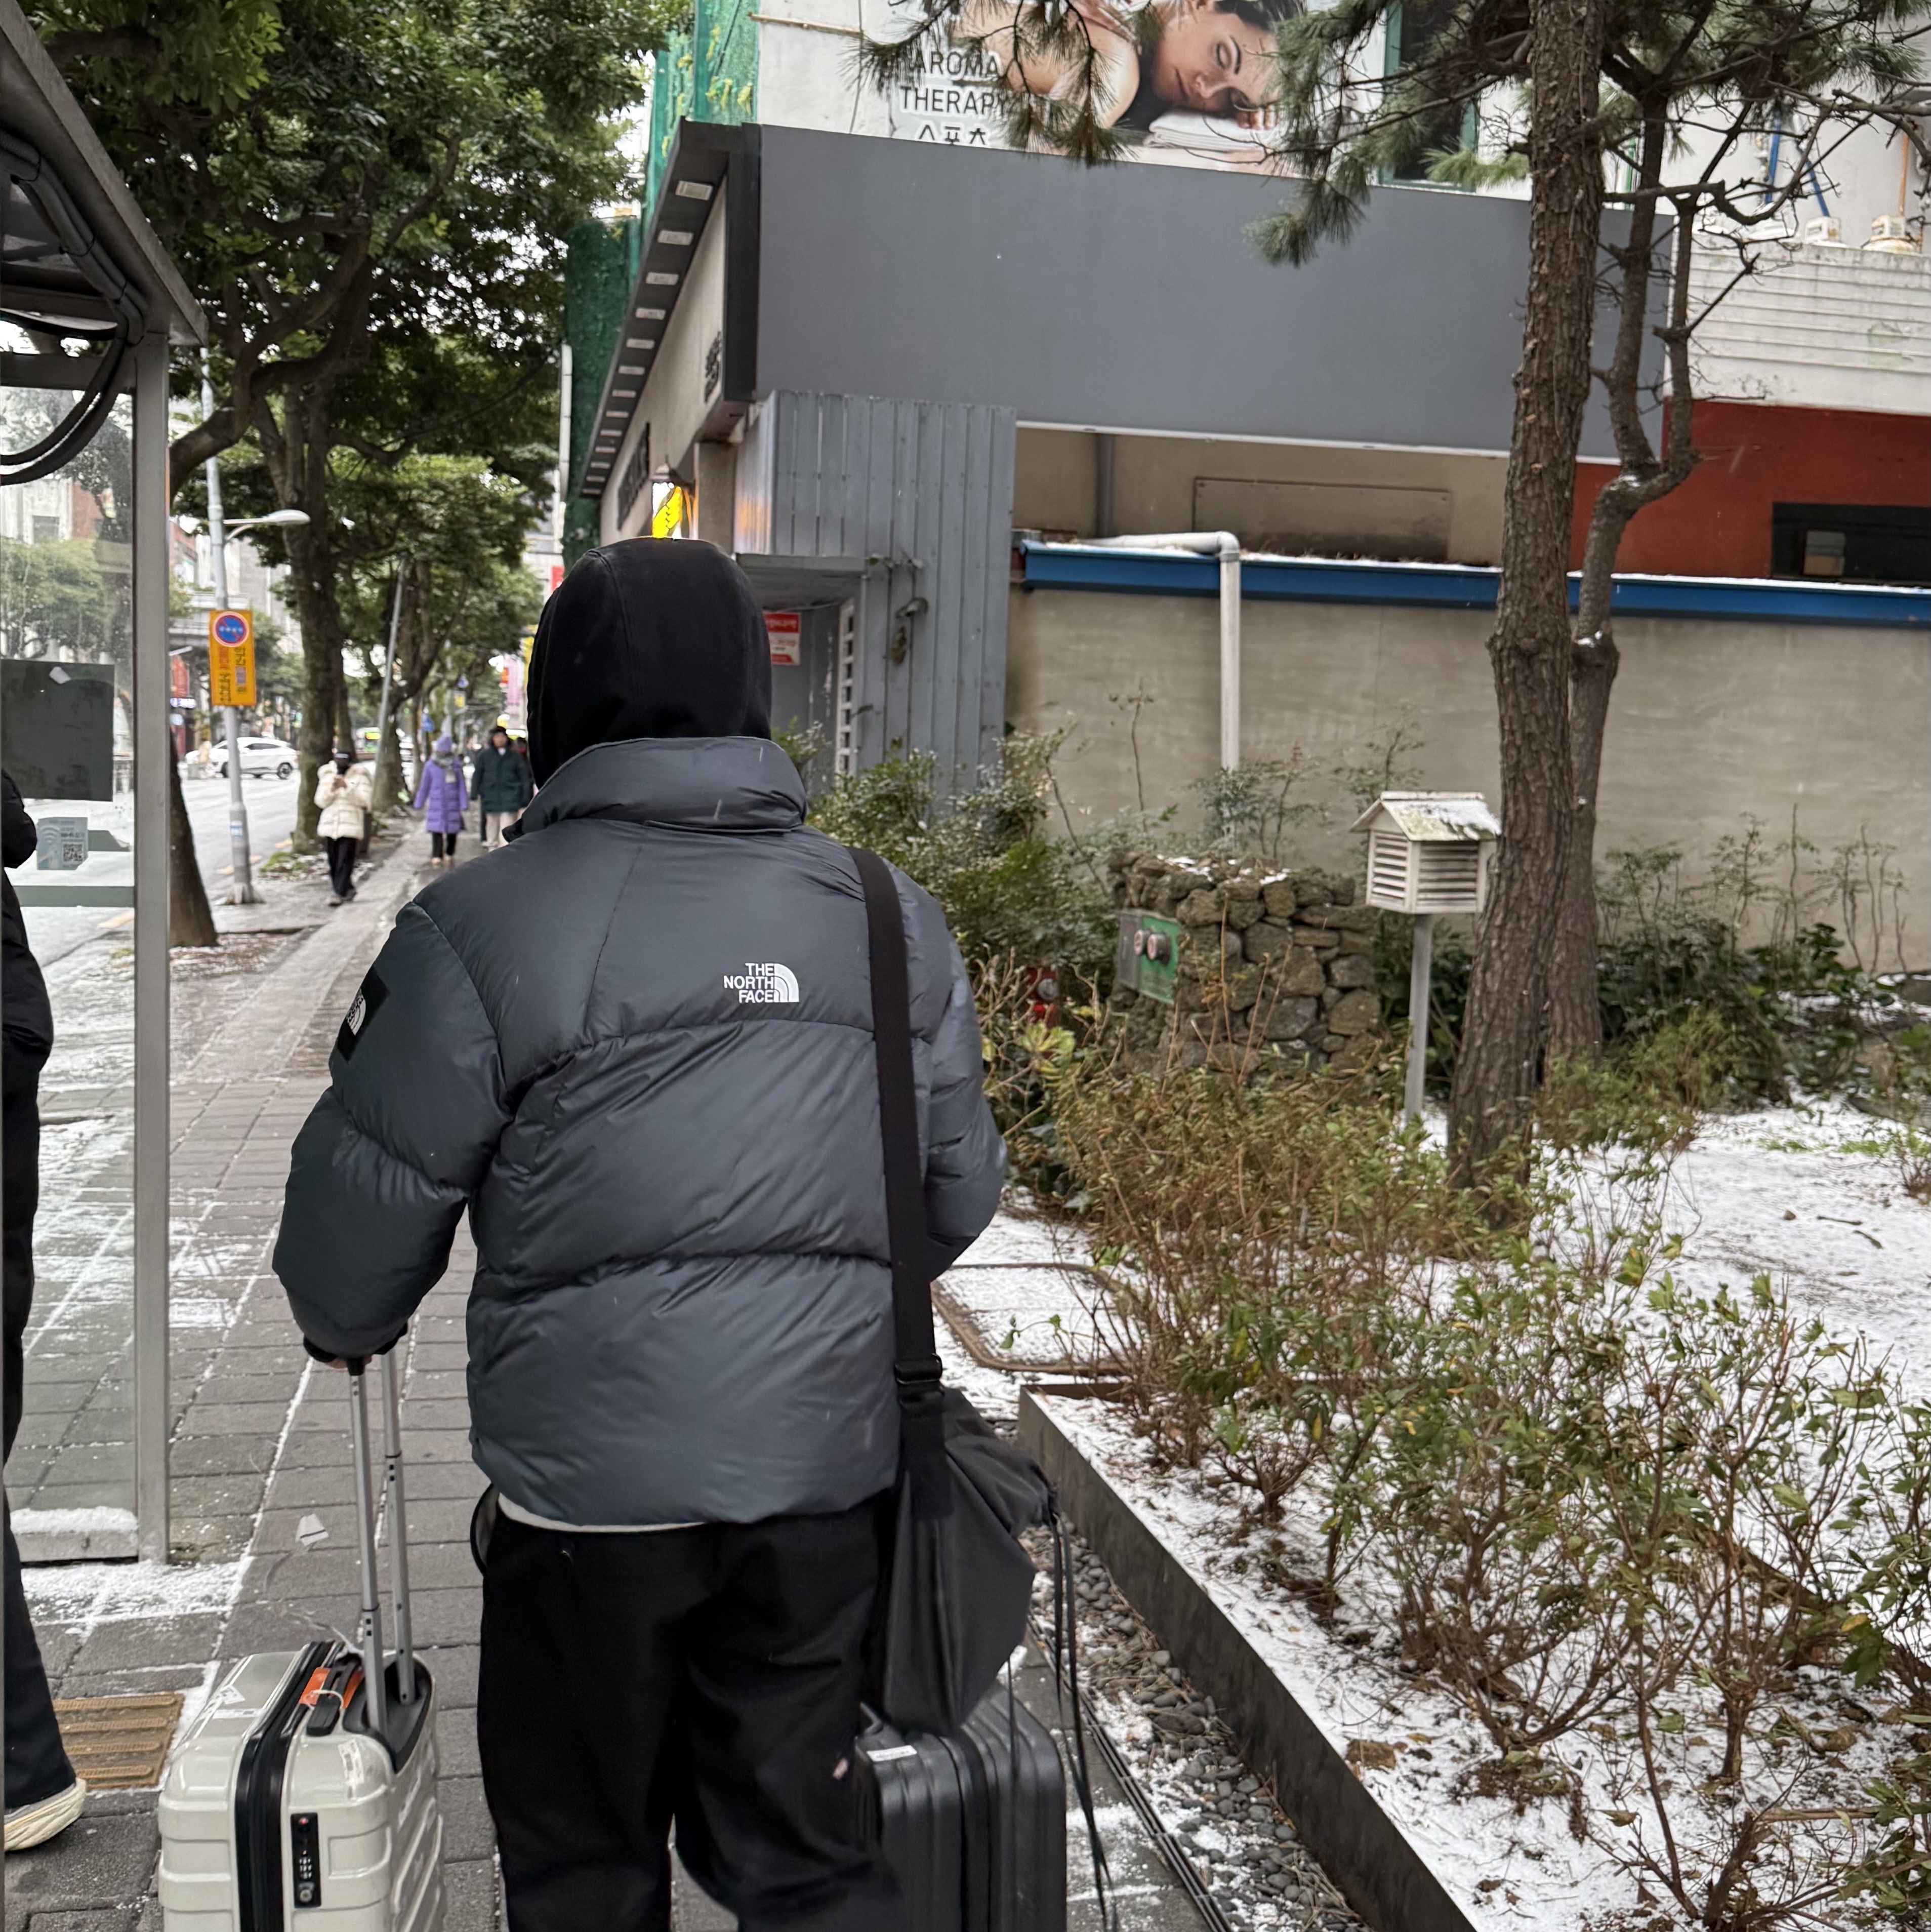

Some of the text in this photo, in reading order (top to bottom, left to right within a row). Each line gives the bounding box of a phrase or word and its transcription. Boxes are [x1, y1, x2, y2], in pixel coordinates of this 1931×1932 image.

[745, 963, 774, 976] THE
[723, 976, 774, 989] NORTH
[738, 989, 774, 1003] FACE
